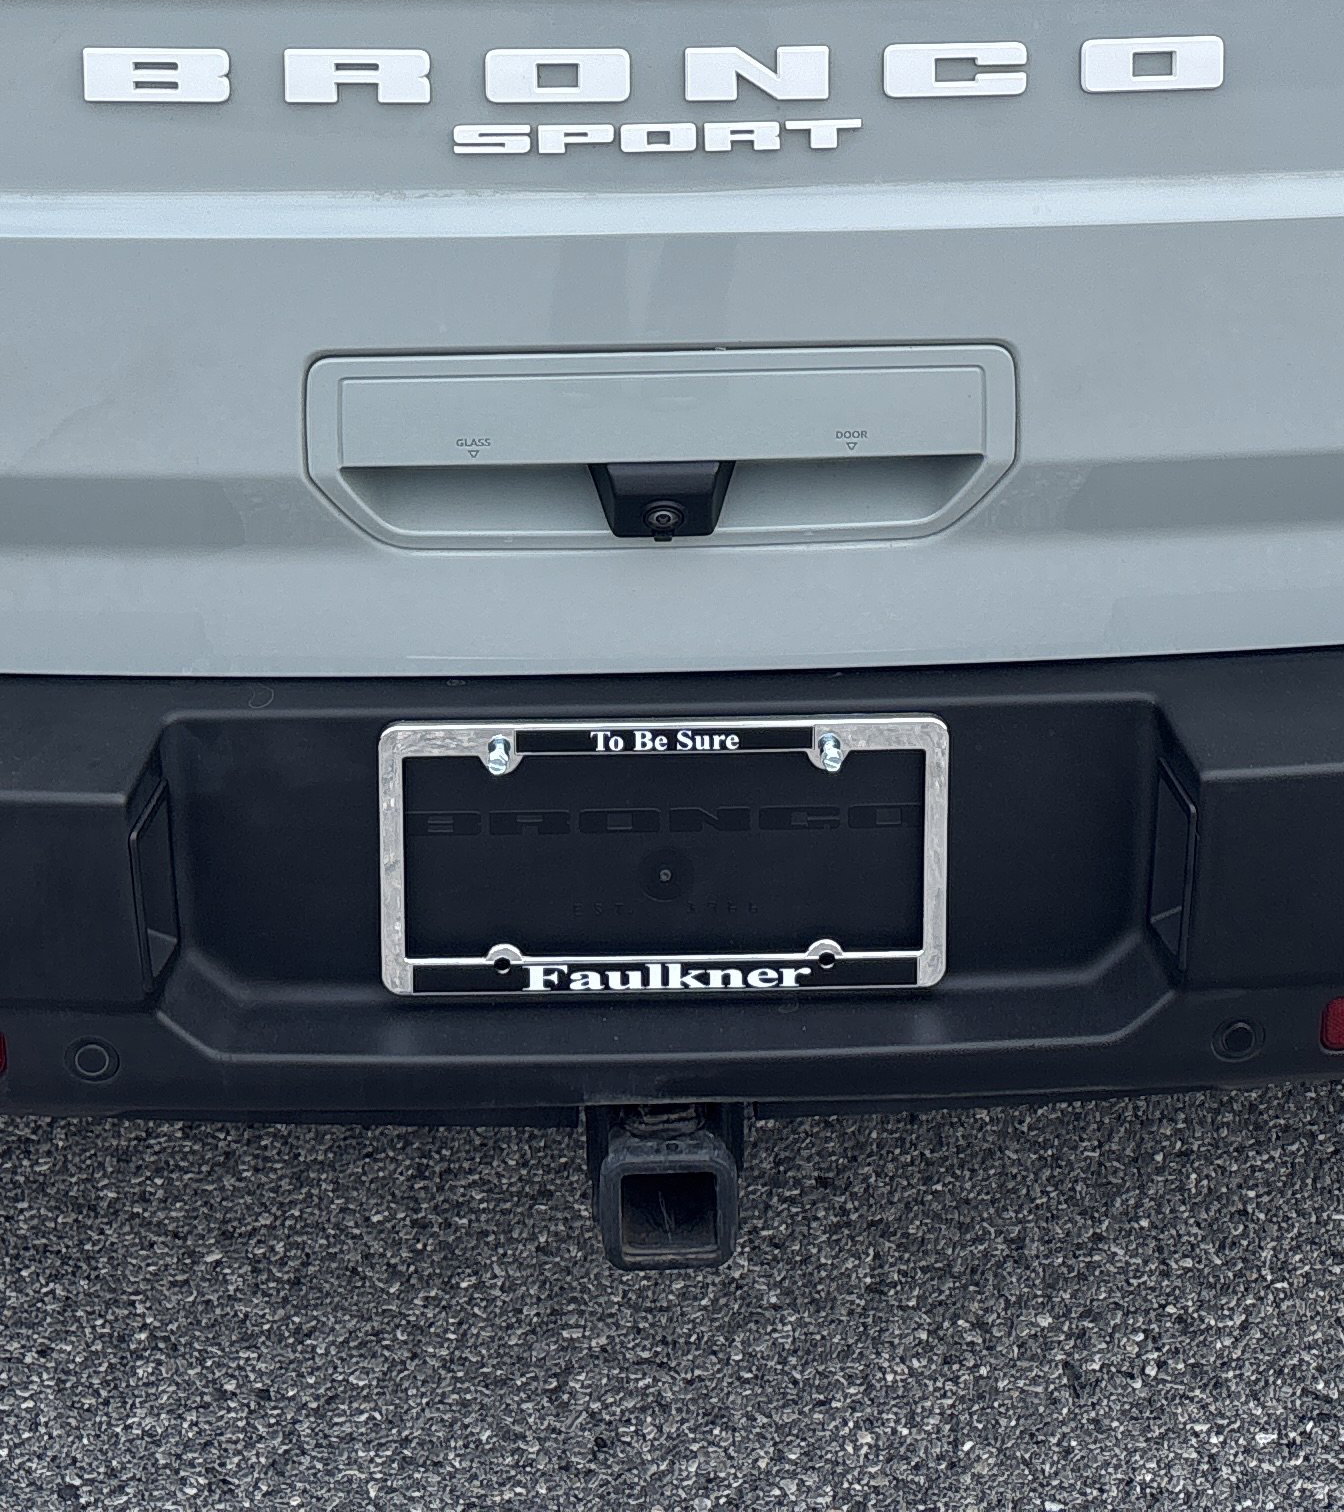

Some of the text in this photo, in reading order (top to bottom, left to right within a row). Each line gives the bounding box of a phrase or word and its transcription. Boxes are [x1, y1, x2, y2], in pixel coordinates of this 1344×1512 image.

[81, 35, 1225, 103] BRONCO
[453, 118, 862, 154] SPORT
[456, 438, 491, 447] GLASS
[836, 430, 868, 439] DOOR
[590, 729, 740, 751] To Be Sure
[404, 803, 922, 836] BRONCO
[522, 963, 812, 992] Faulkner
